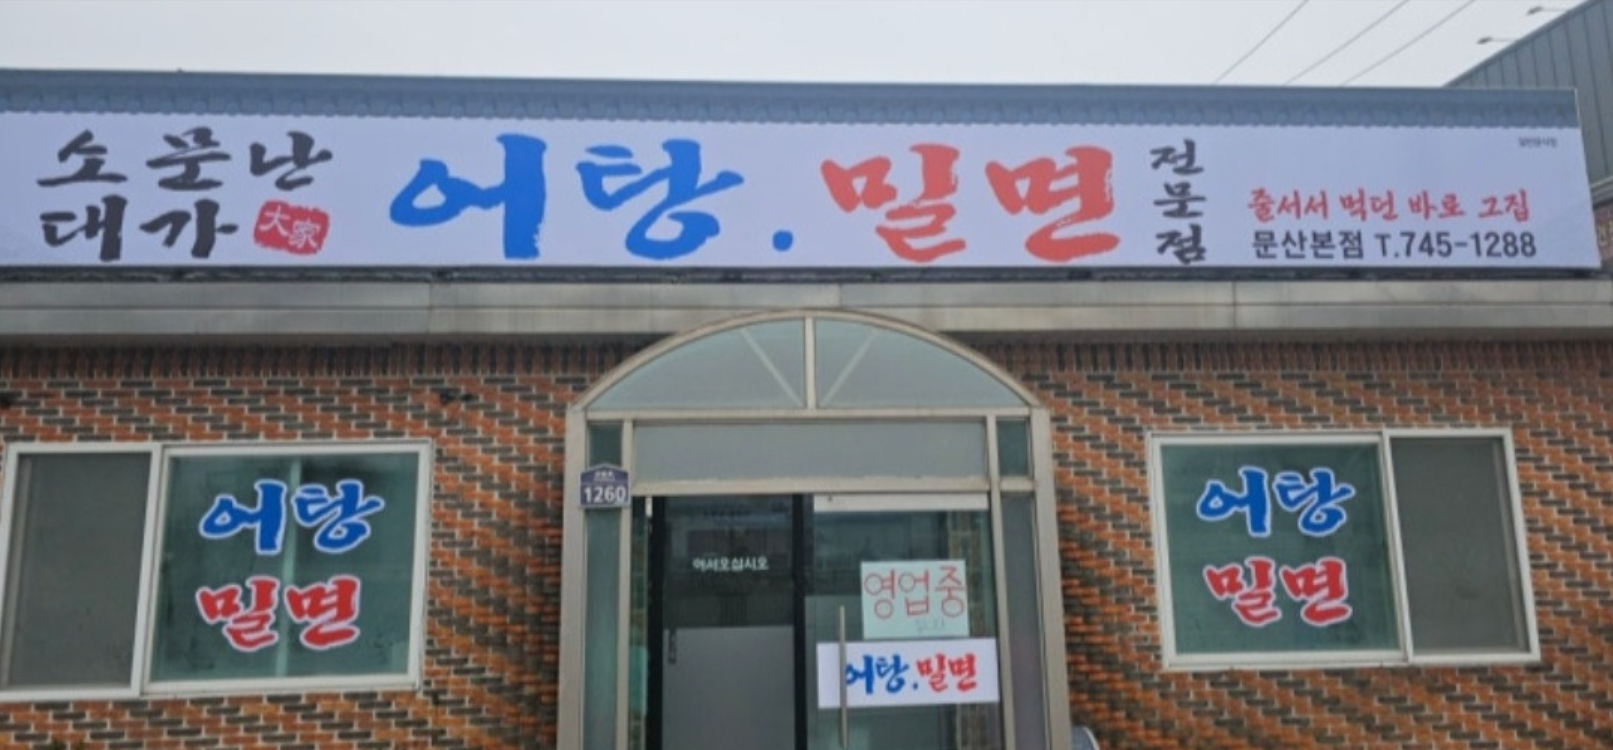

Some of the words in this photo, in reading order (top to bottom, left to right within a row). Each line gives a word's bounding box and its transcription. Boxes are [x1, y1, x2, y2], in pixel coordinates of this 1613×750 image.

[37, 127, 332, 191] 소문난
[40, 194, 238, 262] 대가
[1150, 139, 1207, 264] 전문점
[1248, 187, 1329, 223] 줄서서
[1339, 188, 1398, 223] 먹던
[1407, 190, 1465, 220] 바로
[1252, 230, 1364, 260] 문산본점
[199, 478, 385, 555] 어탕
[584, 486, 626, 503] 1260
[1196, 466, 1355, 537] 어탕
[692, 556, 769, 572] 어서오십시오
[863, 565, 966, 620] 영업중
[1203, 556, 1352, 627] 밀면
[195, 575, 361, 653] 밀면
